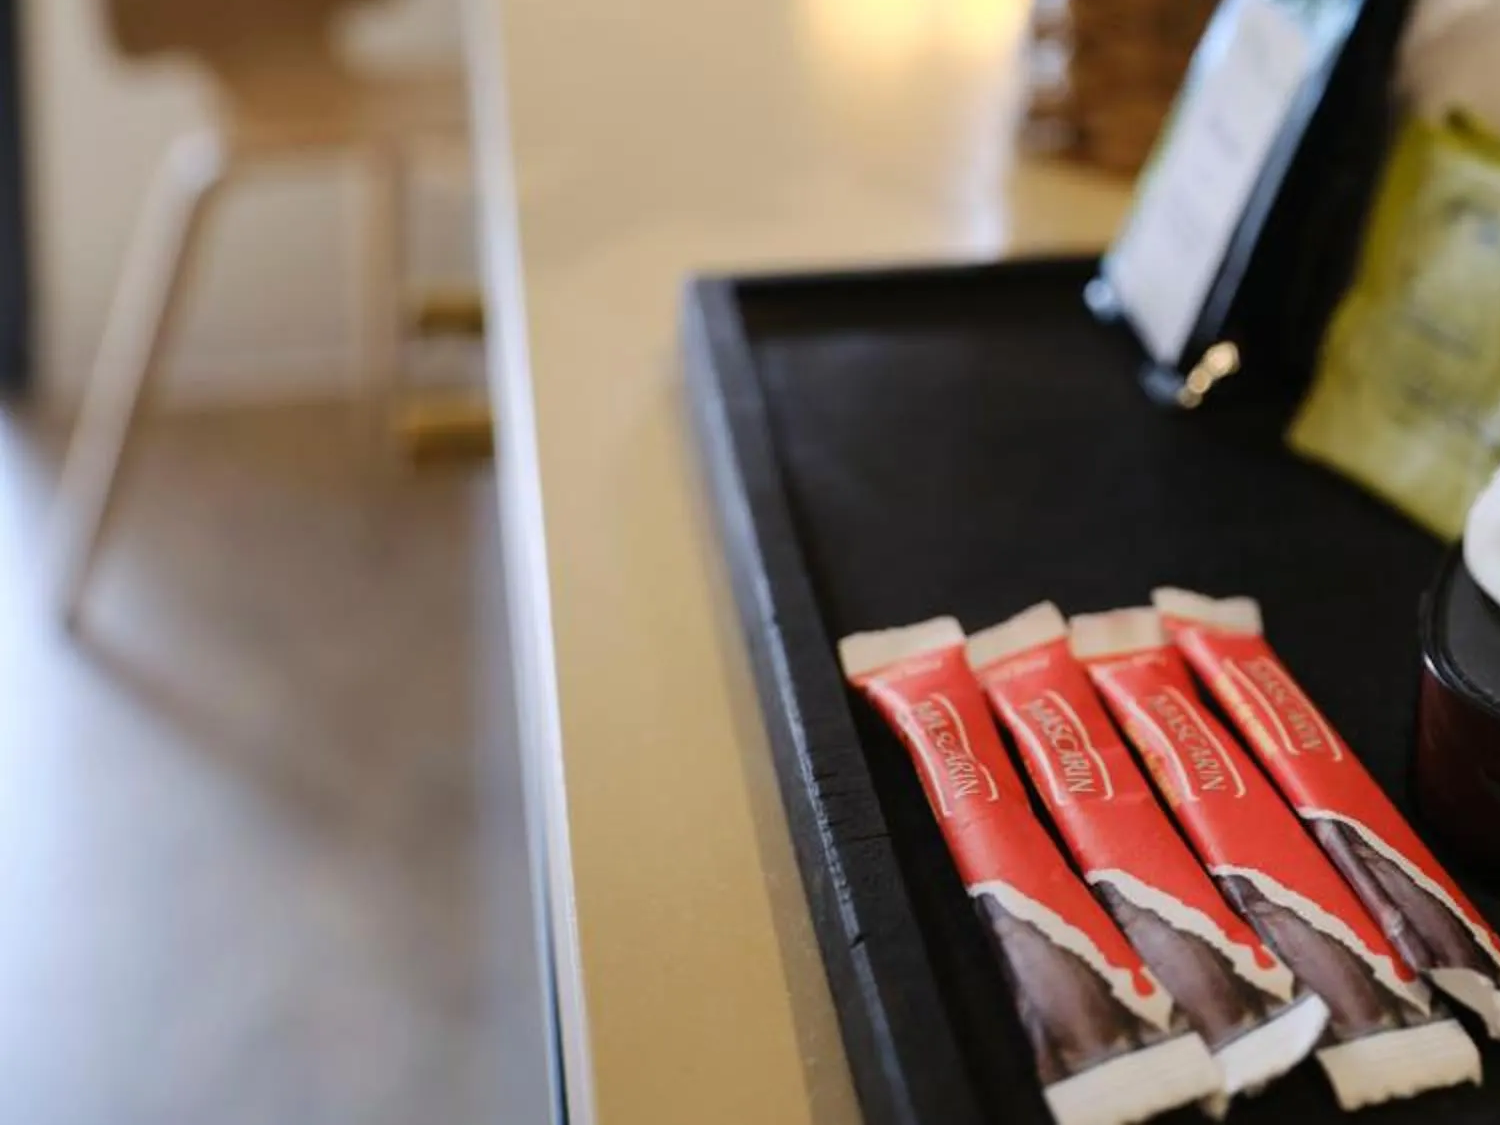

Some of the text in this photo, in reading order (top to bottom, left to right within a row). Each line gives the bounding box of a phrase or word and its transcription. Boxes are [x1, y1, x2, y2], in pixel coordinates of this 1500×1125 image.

[912, 700, 980, 797] MASCARIN
[1019, 699, 1096, 792] MASCARIN
[1147, 694, 1227, 789] MASCARIN
